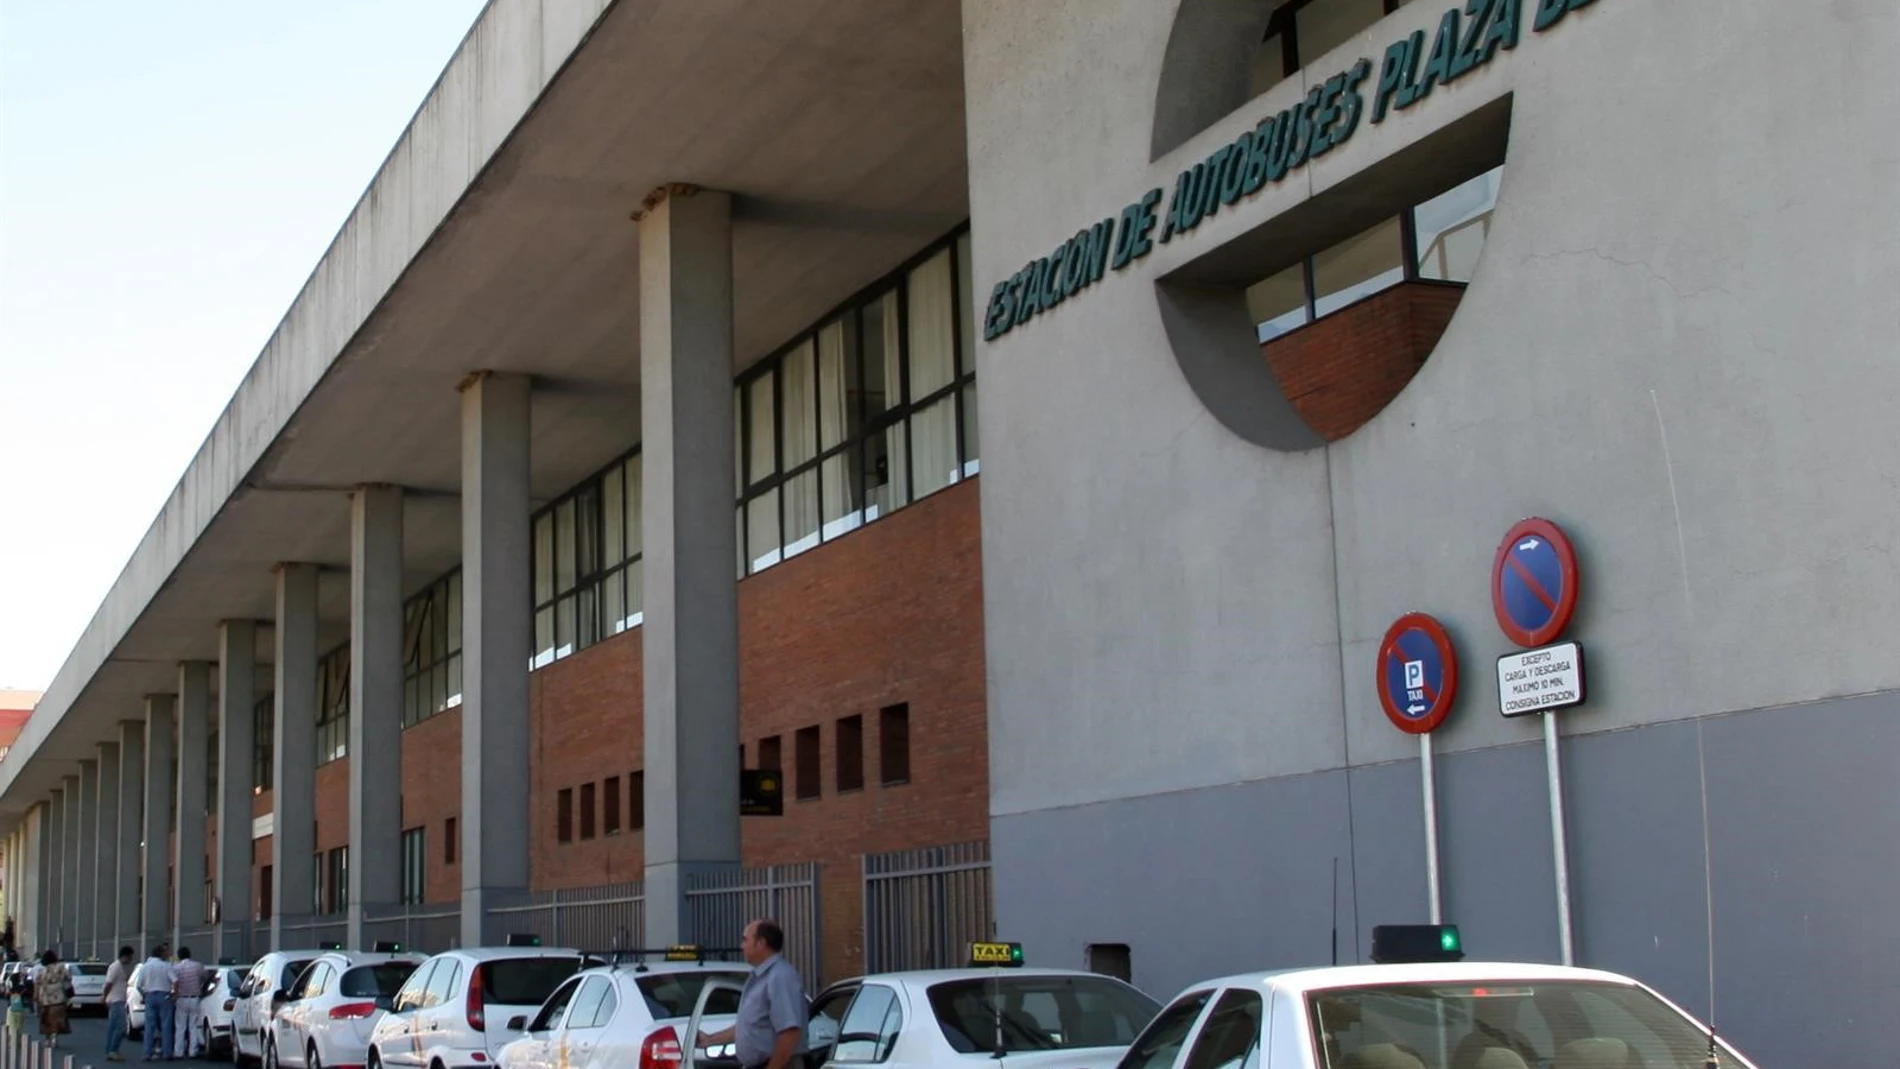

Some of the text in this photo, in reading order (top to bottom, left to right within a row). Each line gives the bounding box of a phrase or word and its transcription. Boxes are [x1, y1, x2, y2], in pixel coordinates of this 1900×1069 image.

[984, 0, 1521, 341] ESTACION DE AUTOBUSES PLAZA
[1521, 652, 1551, 666] EXCEPTO
[1407, 664, 1420, 687] P
[1504, 661, 1571, 682] CARGA Y DESCARGA
[1407, 689, 1424, 702] TAXI
[1512, 681, 1539, 694] MAXIMO
[1541, 679, 1549, 688] 10
[1505, 690, 1575, 711] CONSIGNA ESTACION
[975, 946, 1009, 956] TAXI
